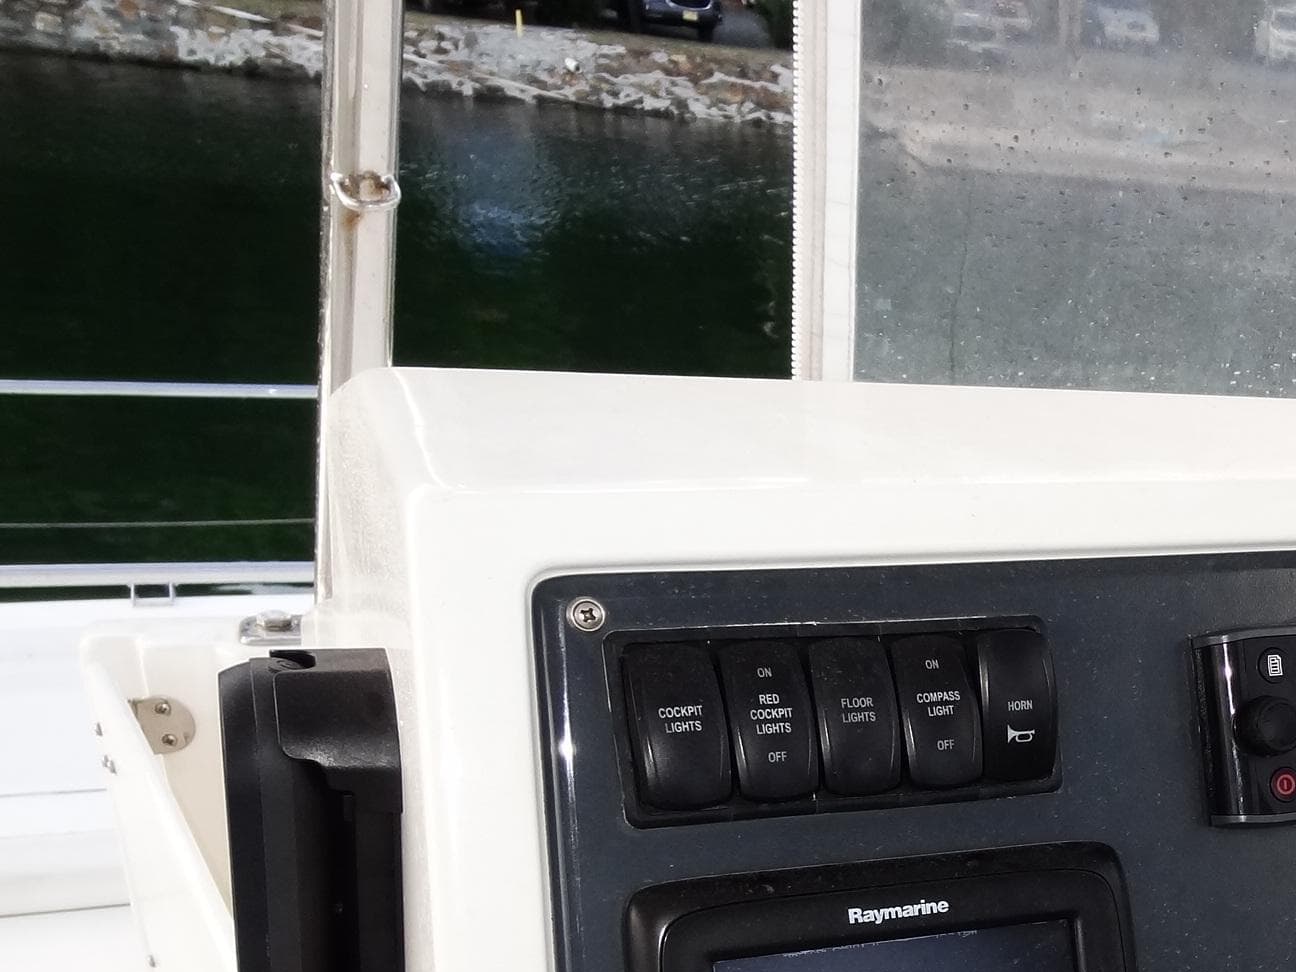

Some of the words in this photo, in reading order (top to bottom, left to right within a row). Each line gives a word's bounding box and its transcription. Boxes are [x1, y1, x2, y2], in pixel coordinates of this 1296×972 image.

[925, 659, 939, 670] ON
[757, 667, 772, 678] ON
[758, 693, 780, 705] RED
[840, 697, 874, 709] FLOOR
[916, 690, 961, 704] COMPASS
[927, 704, 954, 717] LIGHT
[1007, 699, 1033, 711] HORN
[658, 705, 703, 719] COCKPIT
[750, 707, 793, 720] COCKPIT
[842, 711, 876, 723] LIGHTS
[664, 720, 703, 734] LIGHTS
[756, 722, 792, 735] LIGHTS
[937, 739, 955, 751] OFF
[768, 751, 787, 763] OFF
[847, 899, 950, 925] Raymarine
